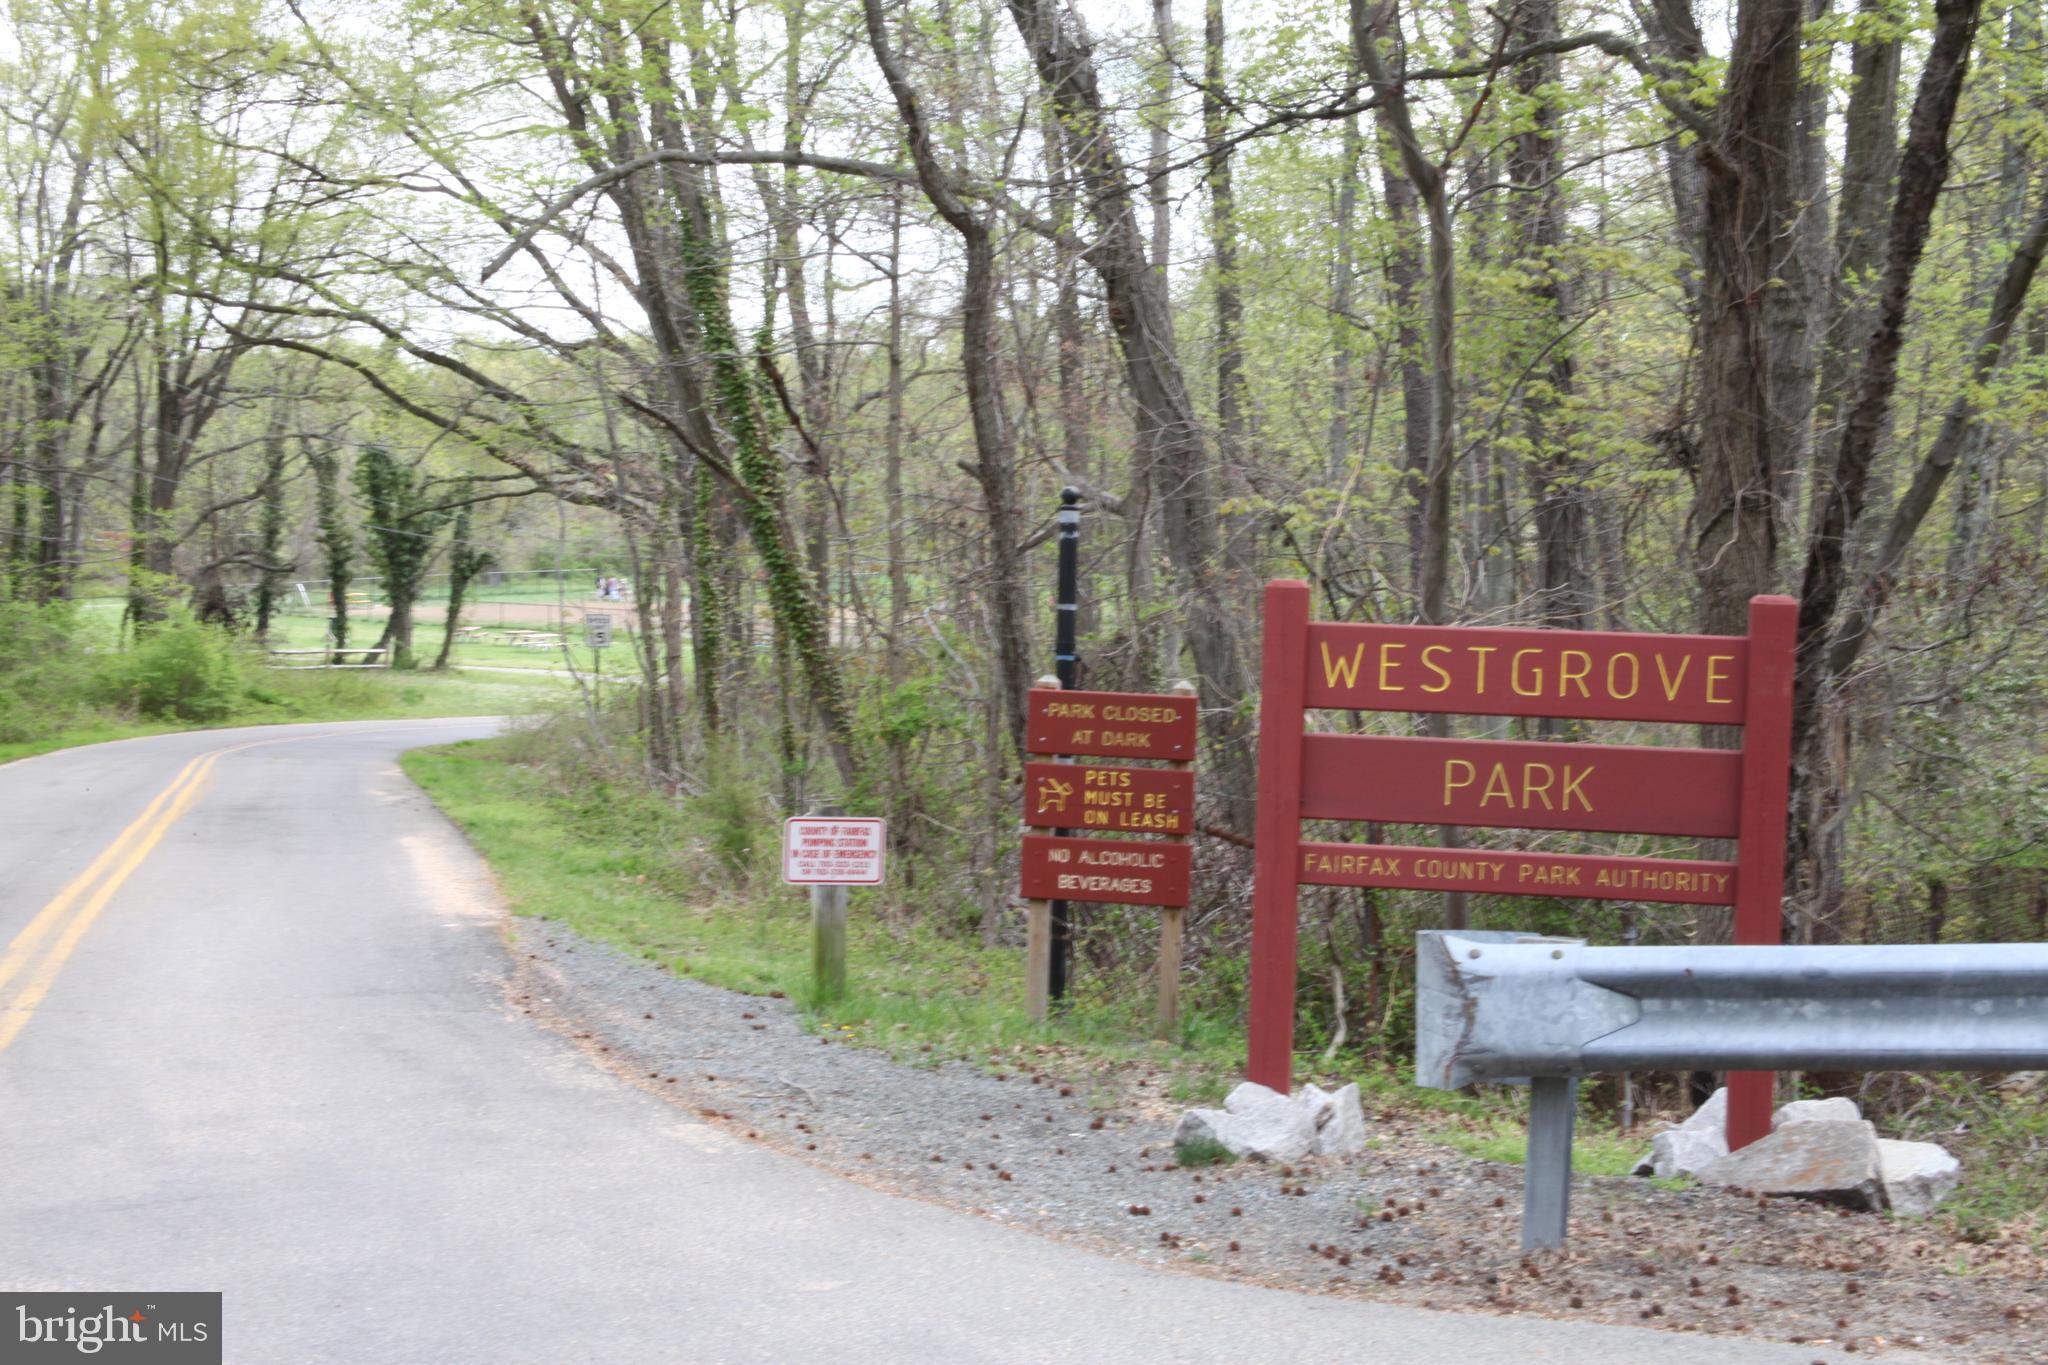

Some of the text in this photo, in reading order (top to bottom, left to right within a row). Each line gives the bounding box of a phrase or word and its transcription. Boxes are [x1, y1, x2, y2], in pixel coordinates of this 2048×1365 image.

[1320, 640, 1736, 704] WESTGROVE
[1047, 702, 1177, 723] PARK CLOSED
[1071, 730, 1152, 748] AT DARK
[1084, 770, 1132, 787] PETS
[1442, 759, 1596, 812] PARK
[1083, 791, 1167, 809] MUST BE
[1083, 810, 1179, 829] ON LEASH
[1047, 848, 1165, 868] NO ALCOHOLIC
[1304, 852, 1730, 894] FAIRFAX COUNTY PARK AUTHORITY
[1057, 874, 1153, 894] BEVERAGES
